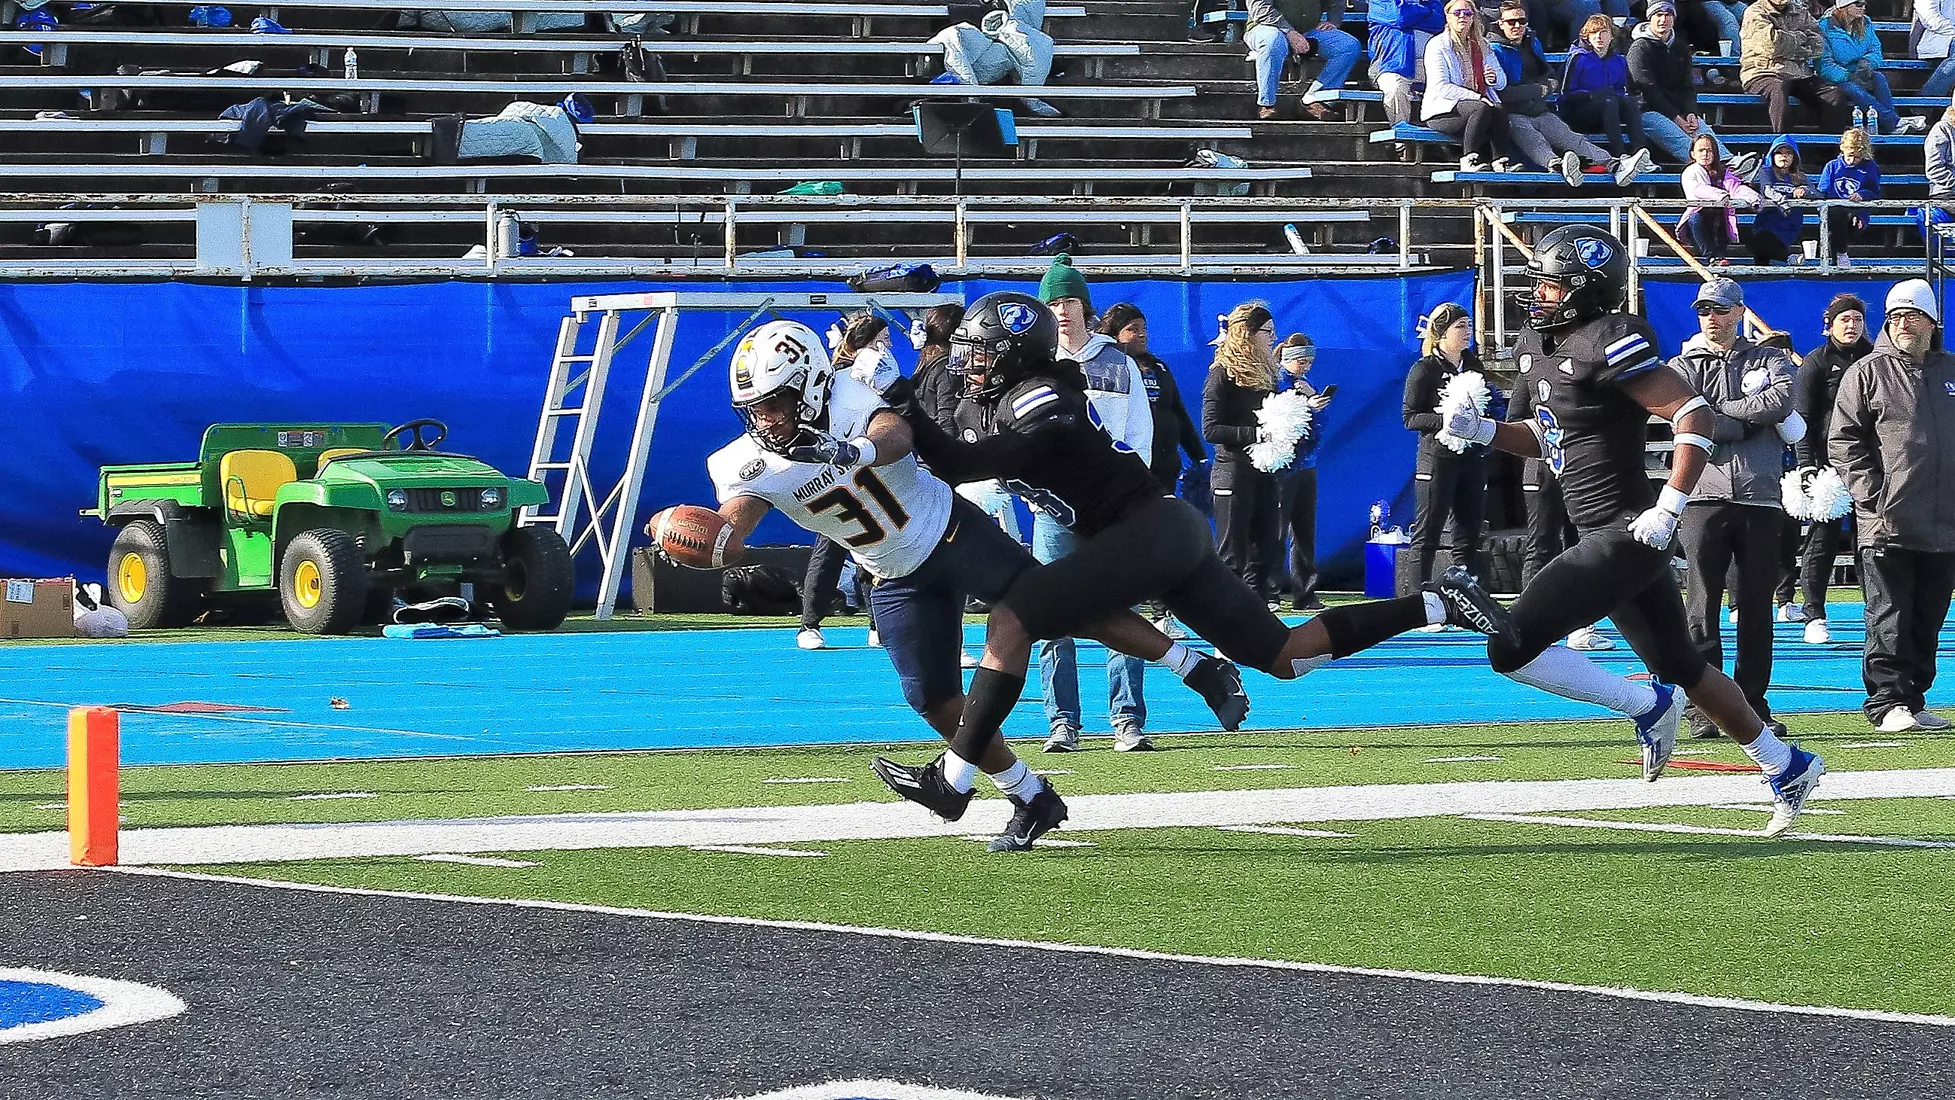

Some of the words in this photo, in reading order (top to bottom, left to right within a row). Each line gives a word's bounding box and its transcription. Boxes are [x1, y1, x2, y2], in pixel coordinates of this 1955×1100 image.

[775, 334, 808, 364] 31
[792, 468, 836, 502] MURRAY
[802, 463, 912, 548] 31
